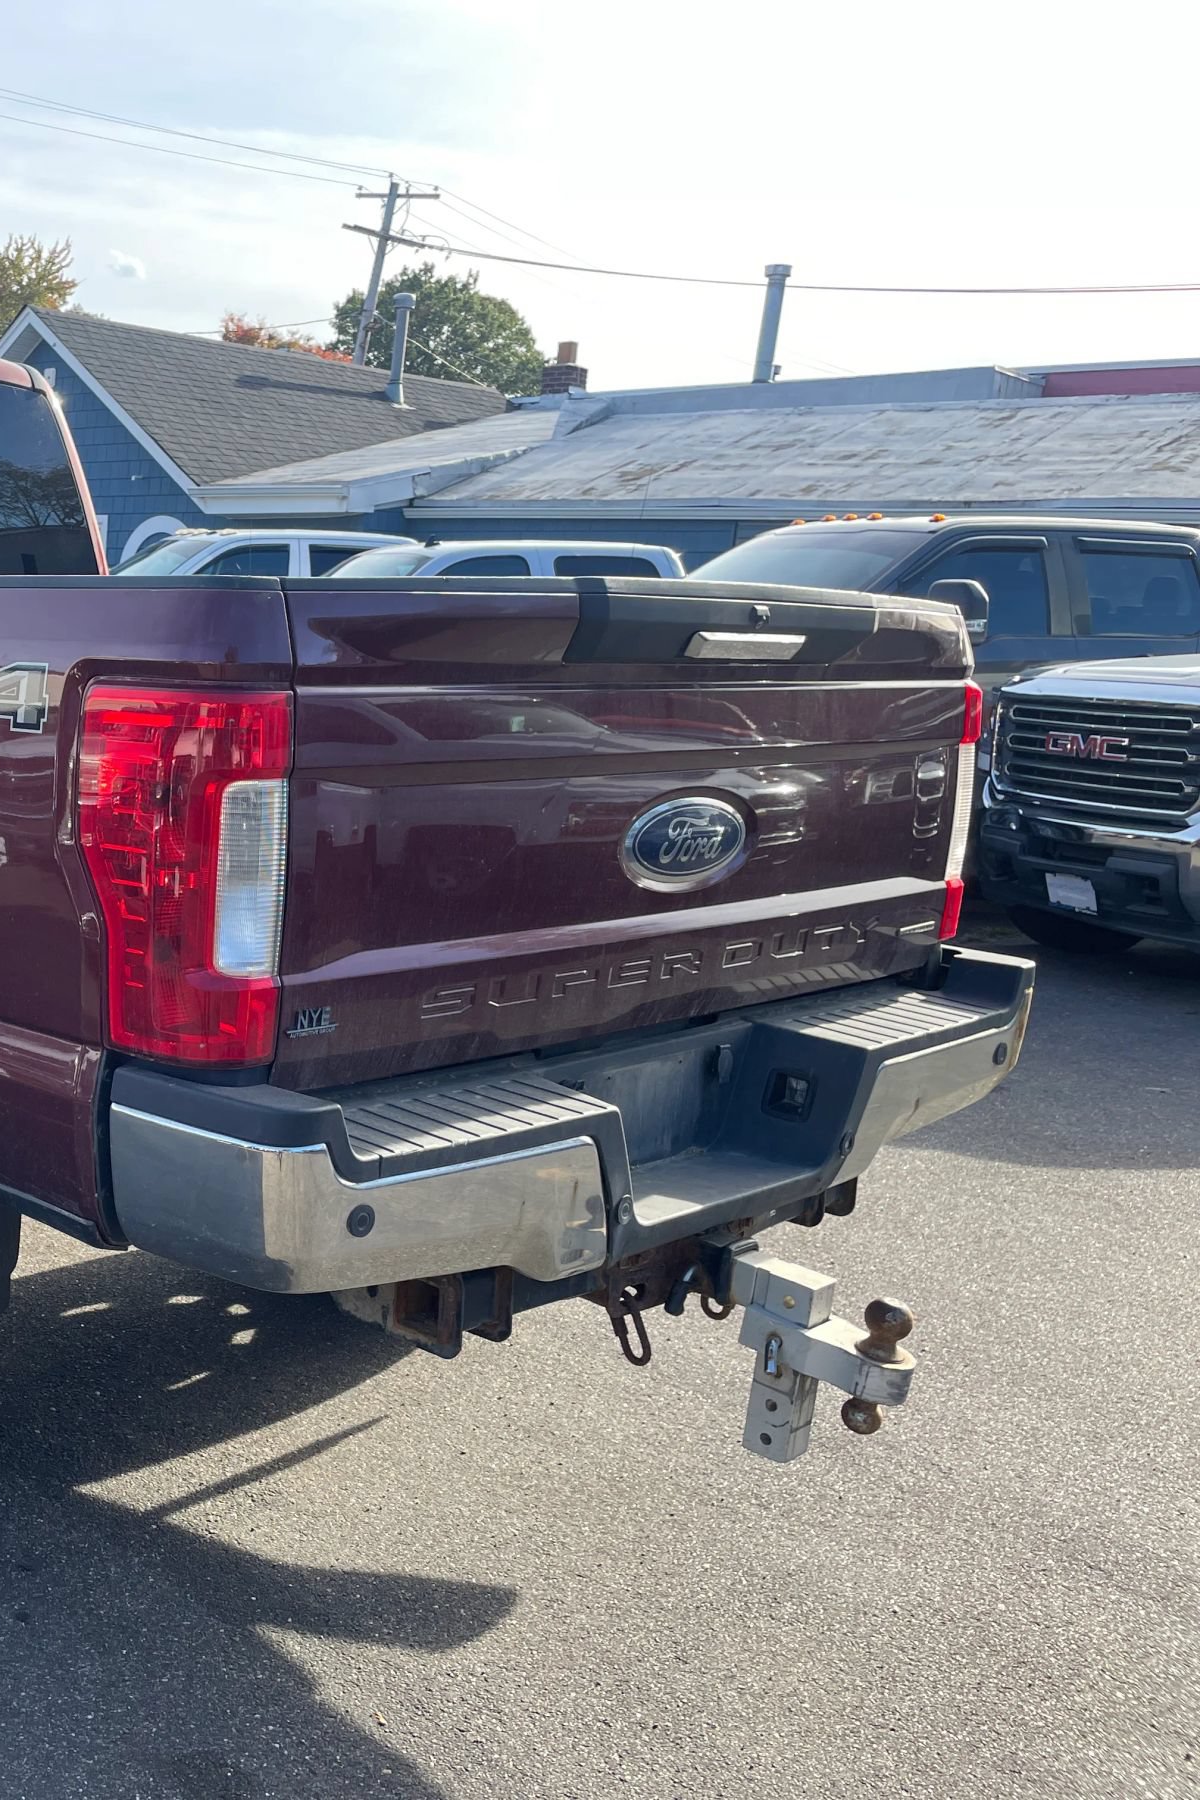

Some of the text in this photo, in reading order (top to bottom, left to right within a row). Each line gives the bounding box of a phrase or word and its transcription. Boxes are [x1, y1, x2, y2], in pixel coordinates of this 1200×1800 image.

[1045, 731, 1129, 762] GMC
[659, 816, 725, 864] Ford
[421, 915, 880, 1020] SUPER DUTY
[297, 1006, 331, 1029] NYE
